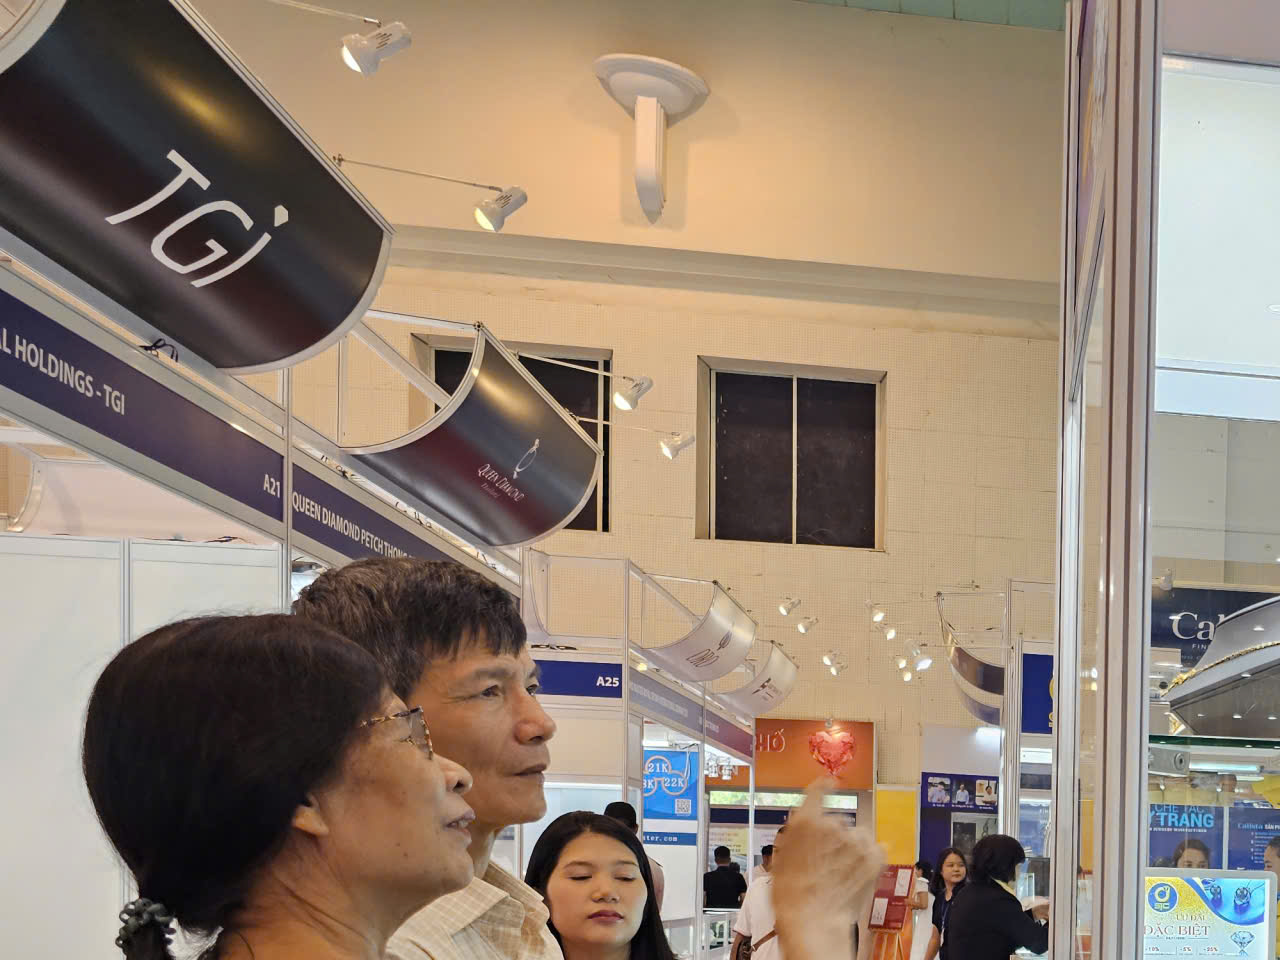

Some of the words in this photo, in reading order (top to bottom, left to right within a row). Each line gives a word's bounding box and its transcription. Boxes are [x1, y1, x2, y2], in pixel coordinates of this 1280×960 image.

[15, 334, 94, 398] HOLDINGS
[103, 383, 125, 416] TGI
[263, 473, 281, 499] A21
[477, 463, 500, 483] QUEEN
[495, 476, 526, 502] DIAMOND
[292, 491, 322, 522] QUEEN
[322, 507, 361, 542] DIAMOND
[361, 529, 384, 555] PETCH
[596, 675, 620, 688] A25
[648, 762, 669, 773] 21K
[664, 777, 684, 787] 22K
[1156, 812, 1215, 828] TRANG
[1144, 922, 1174, 938] ĐẶC
[1178, 923, 1211, 938] BIỆT
